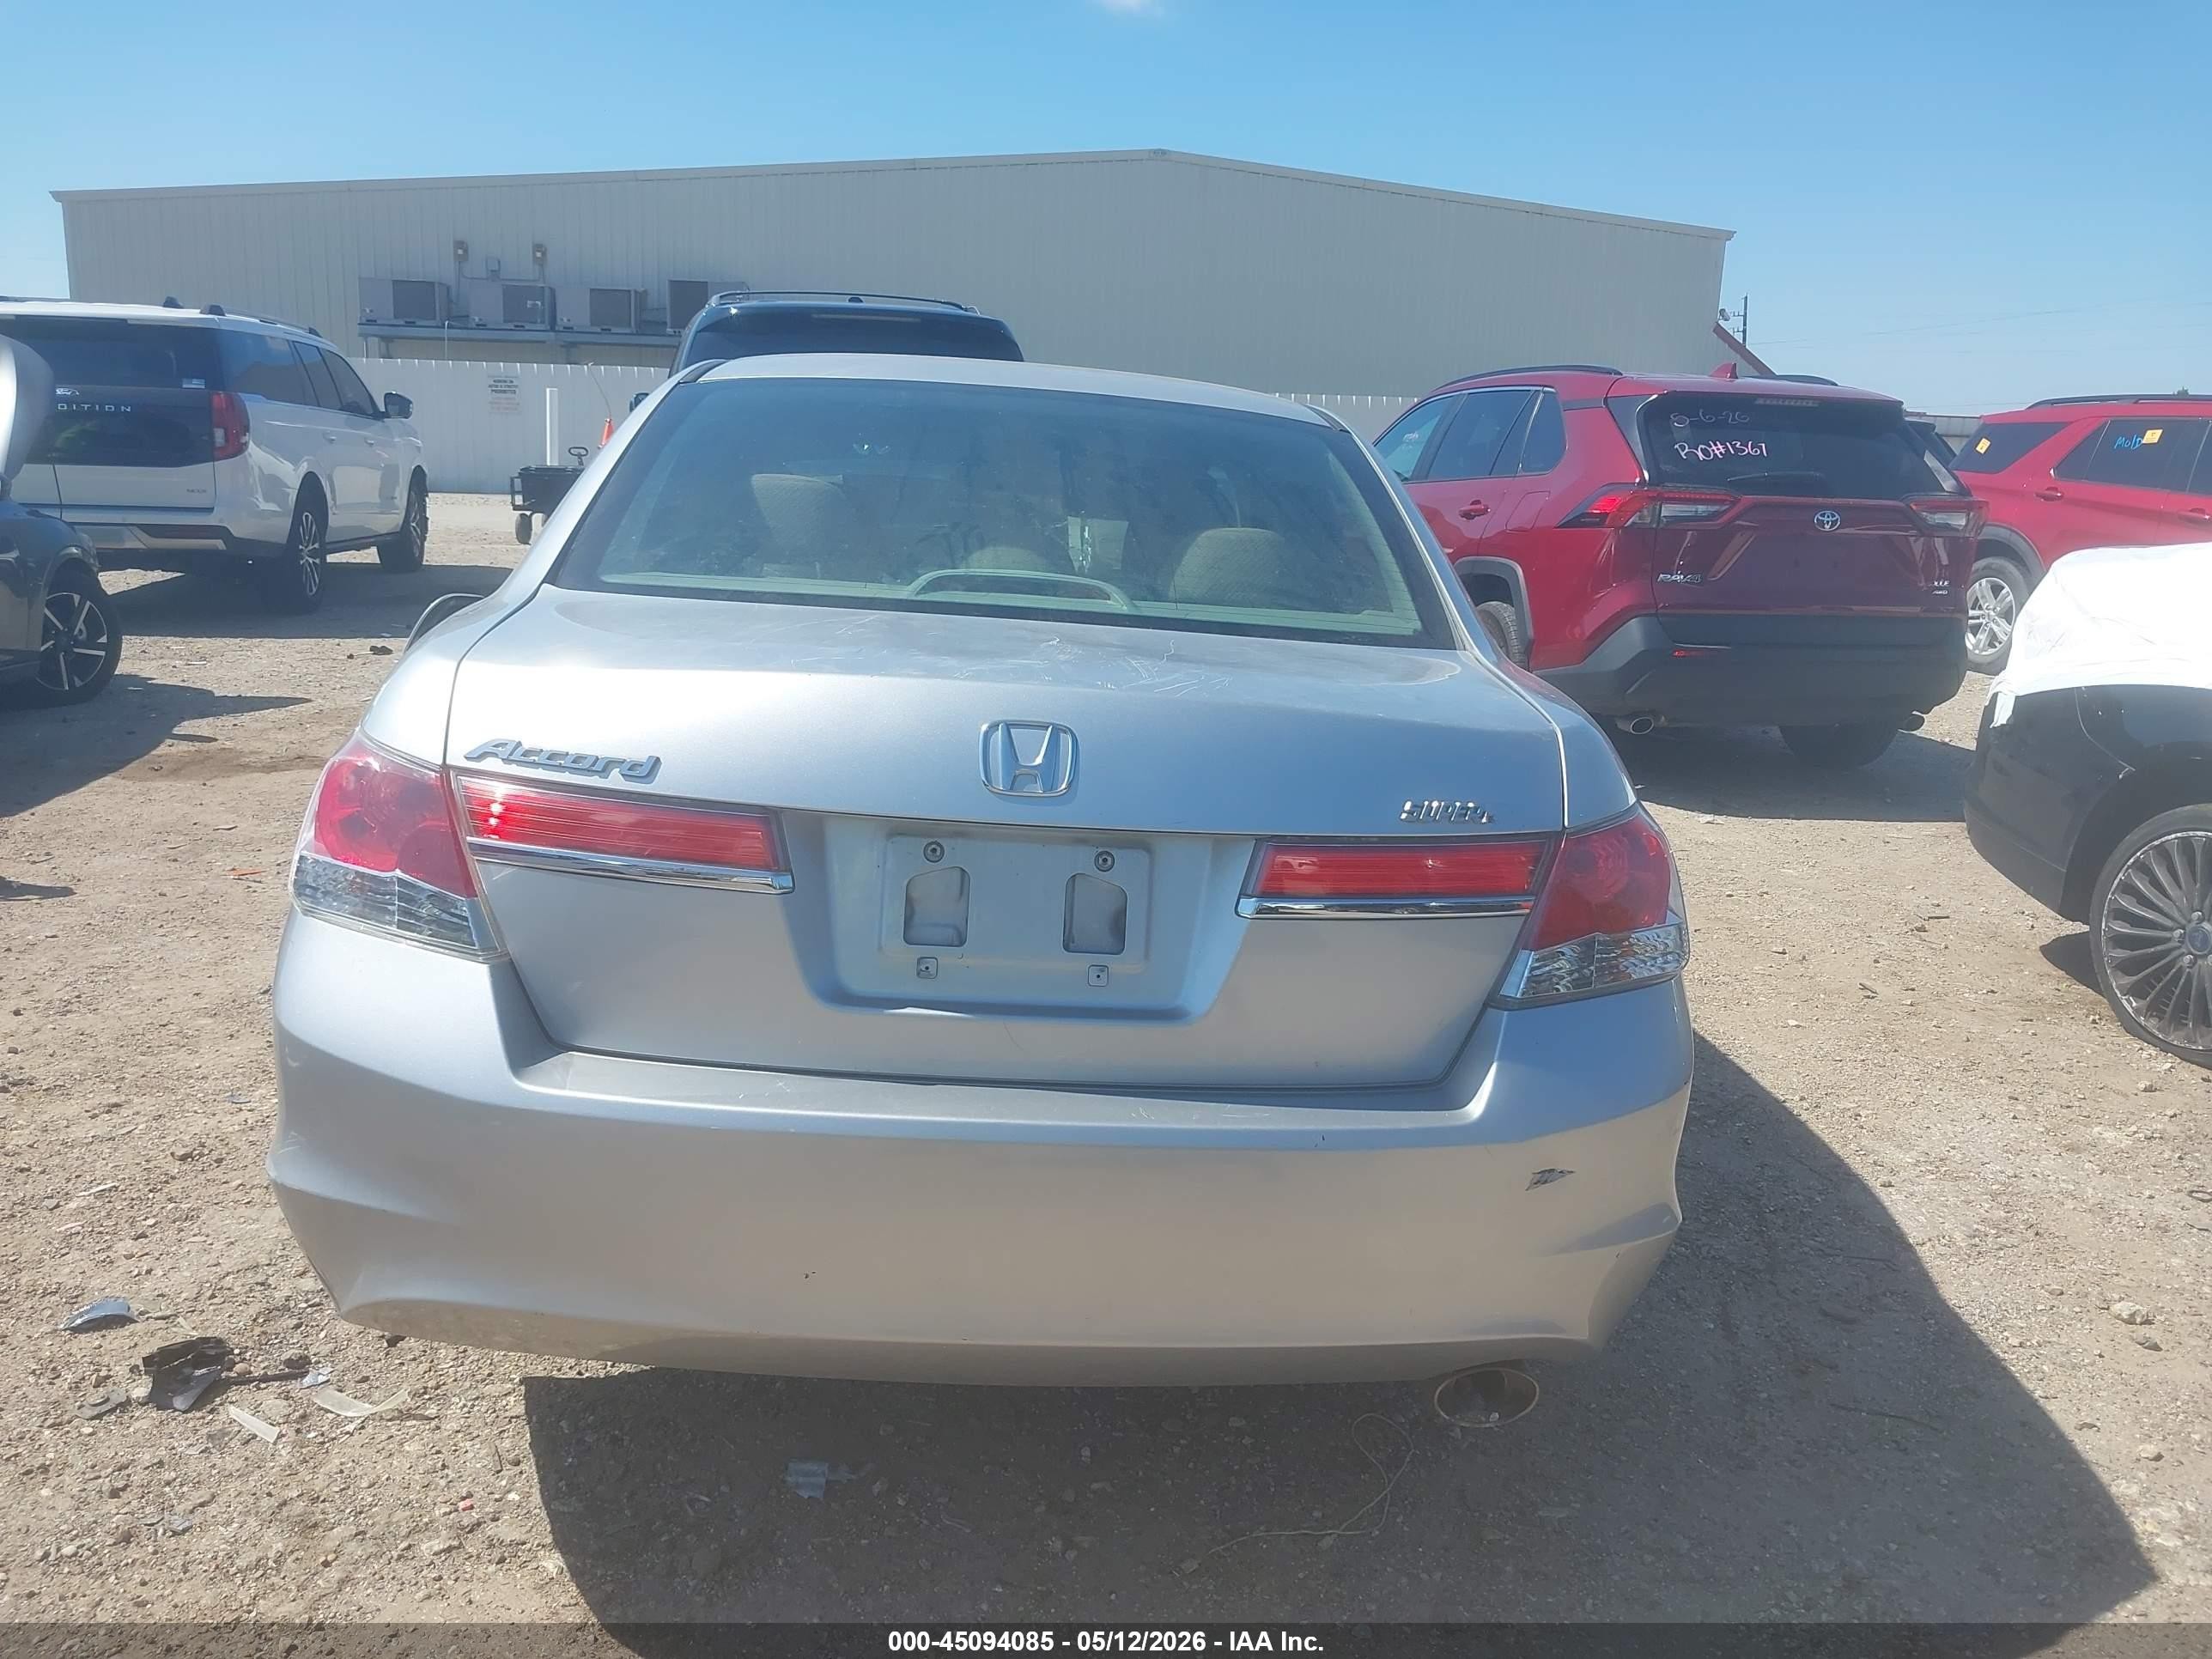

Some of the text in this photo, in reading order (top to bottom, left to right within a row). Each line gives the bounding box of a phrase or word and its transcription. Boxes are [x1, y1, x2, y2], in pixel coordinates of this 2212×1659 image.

[57, 403, 131, 412] DITION
[1674, 441, 1767, 460] RO#1367
[1657, 573, 1702, 583] RAV4
[464, 738, 662, 785] Accord
